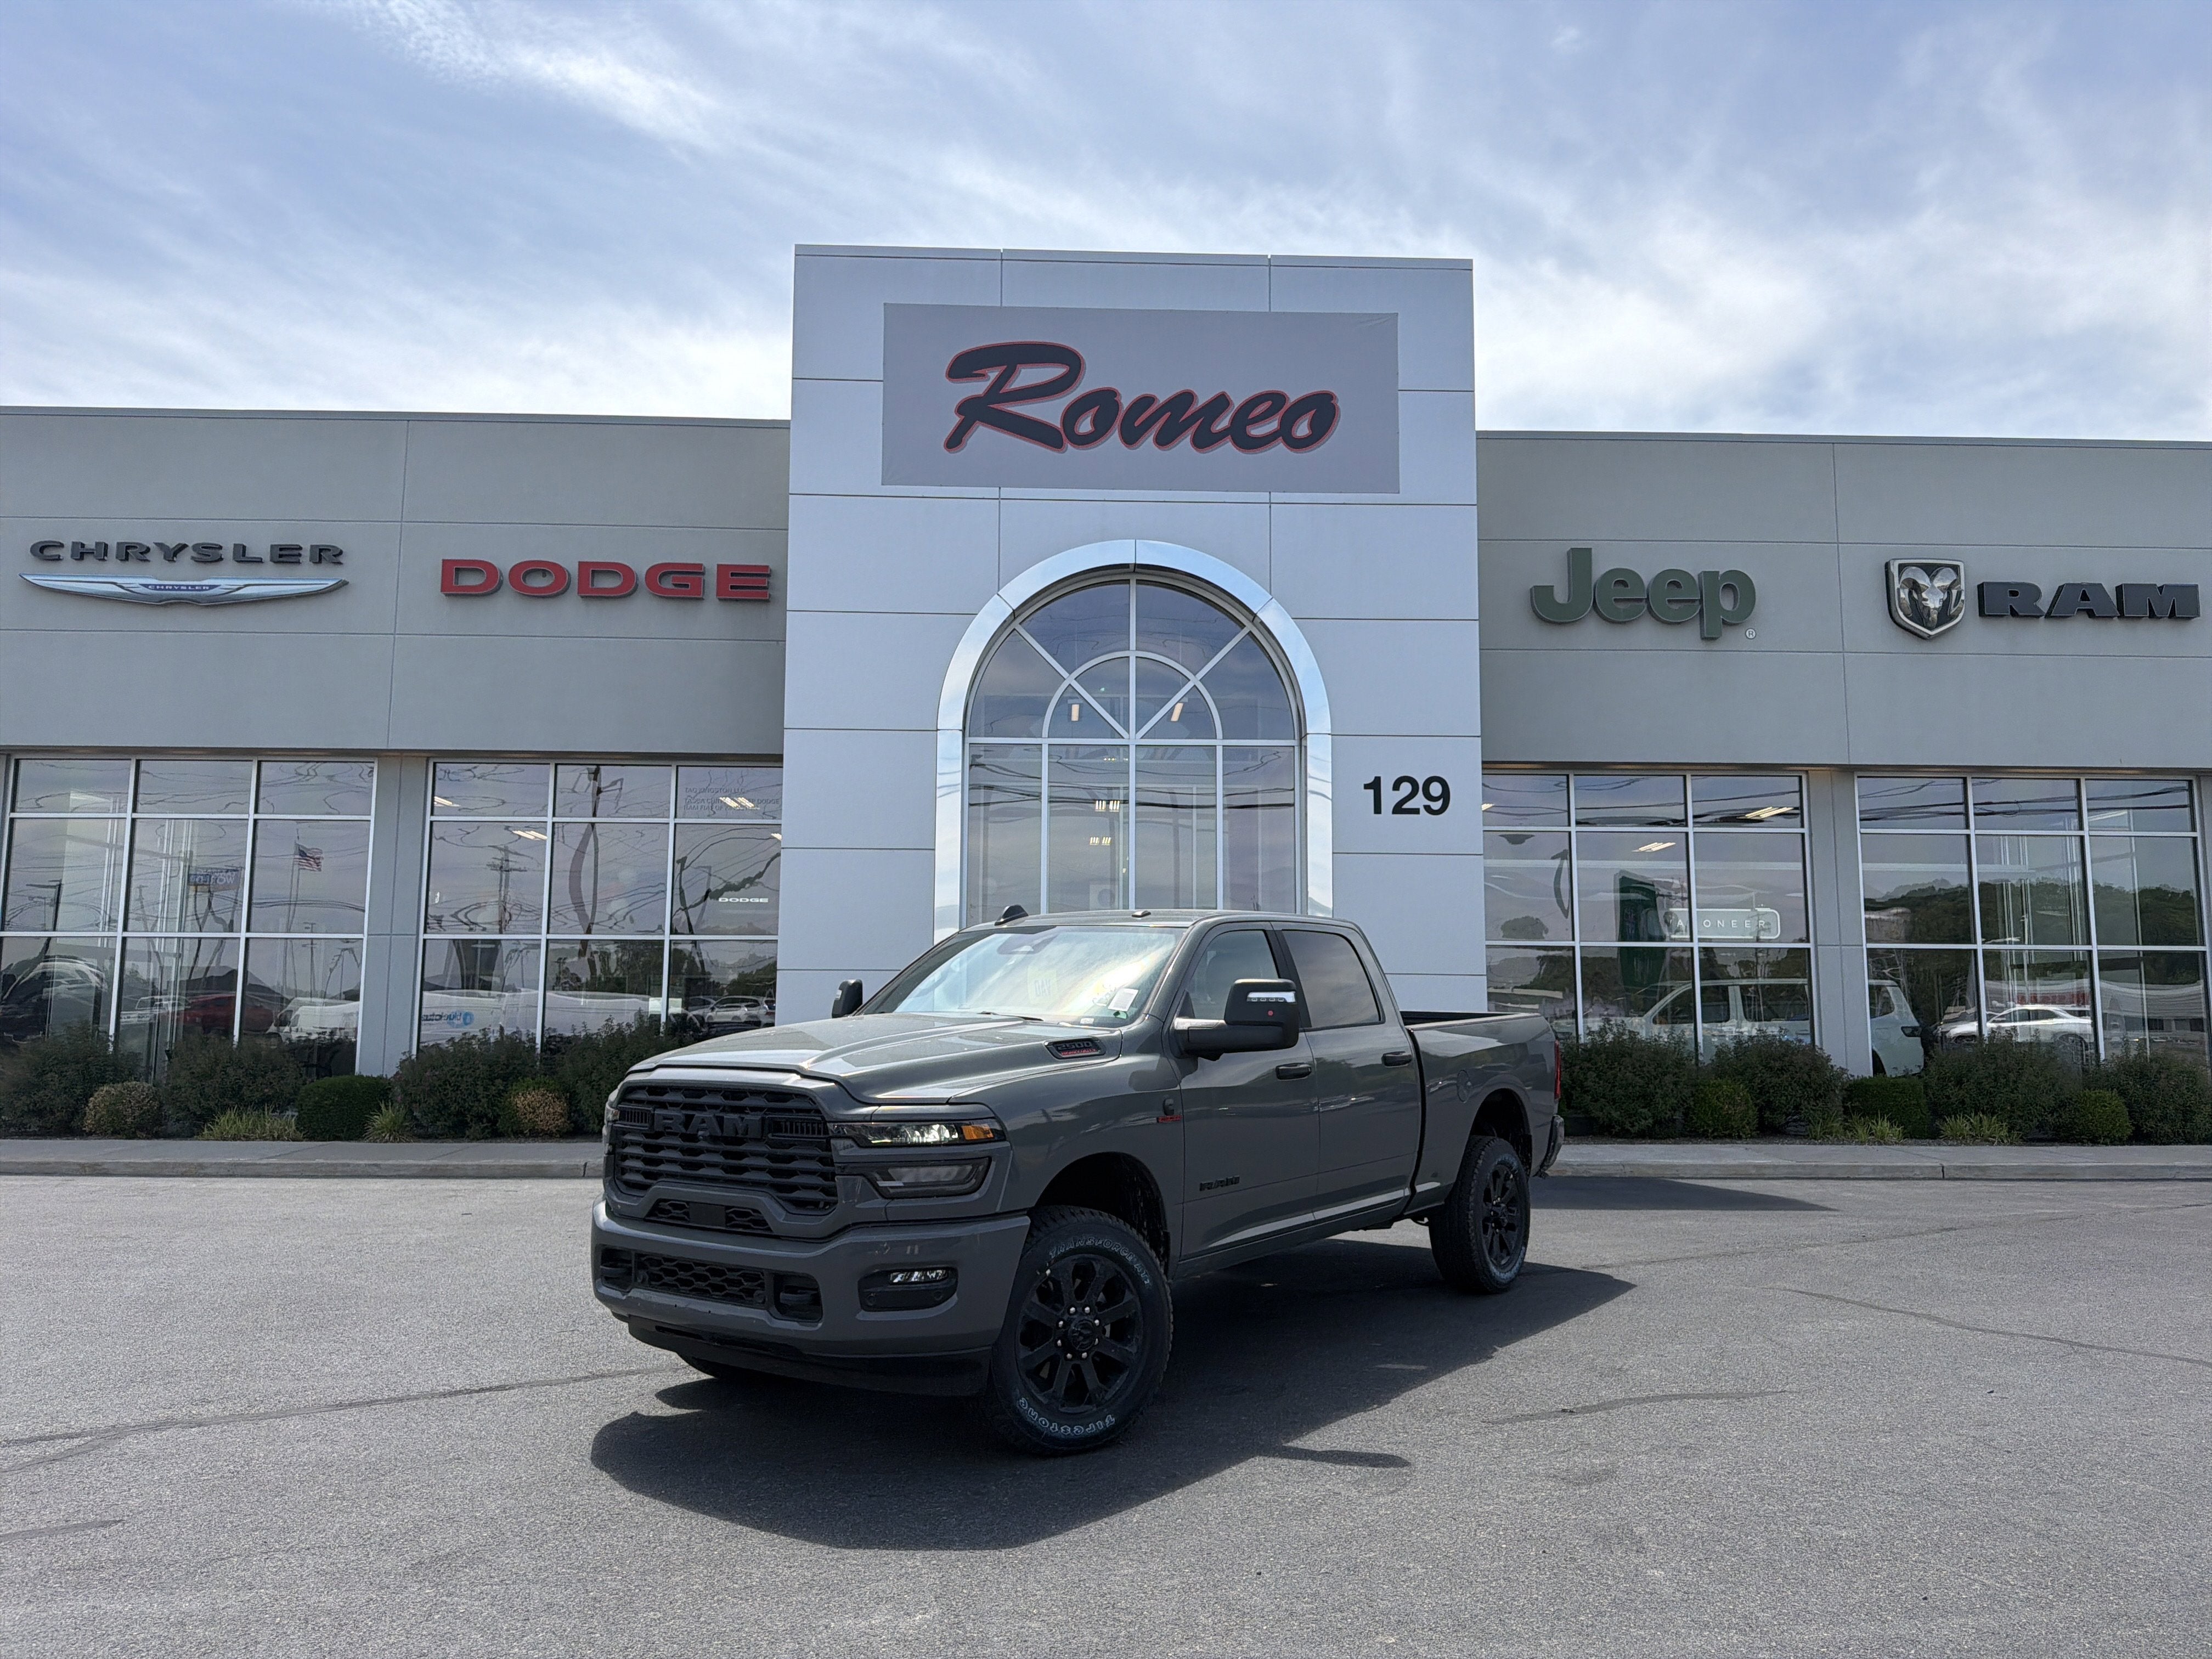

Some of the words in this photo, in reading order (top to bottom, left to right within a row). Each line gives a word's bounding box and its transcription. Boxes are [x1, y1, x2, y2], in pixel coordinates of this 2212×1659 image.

[944, 340, 1340, 453] Romeo
[30, 540, 343, 564] CHRYSLER
[441, 558, 771, 601] DODGE
[1530, 548, 1756, 640] Jeep
[1977, 582, 2200, 619] RAM
[1363, 775, 1451, 815] 129
[1663, 919, 1765, 928] AONEER
[1058, 1041, 1092, 1050] 2500
[654, 1108, 762, 1138] RAM
[1049, 1237, 1136, 1262] TRANSFORCE
[1019, 1397, 1115, 1435] Firestone
